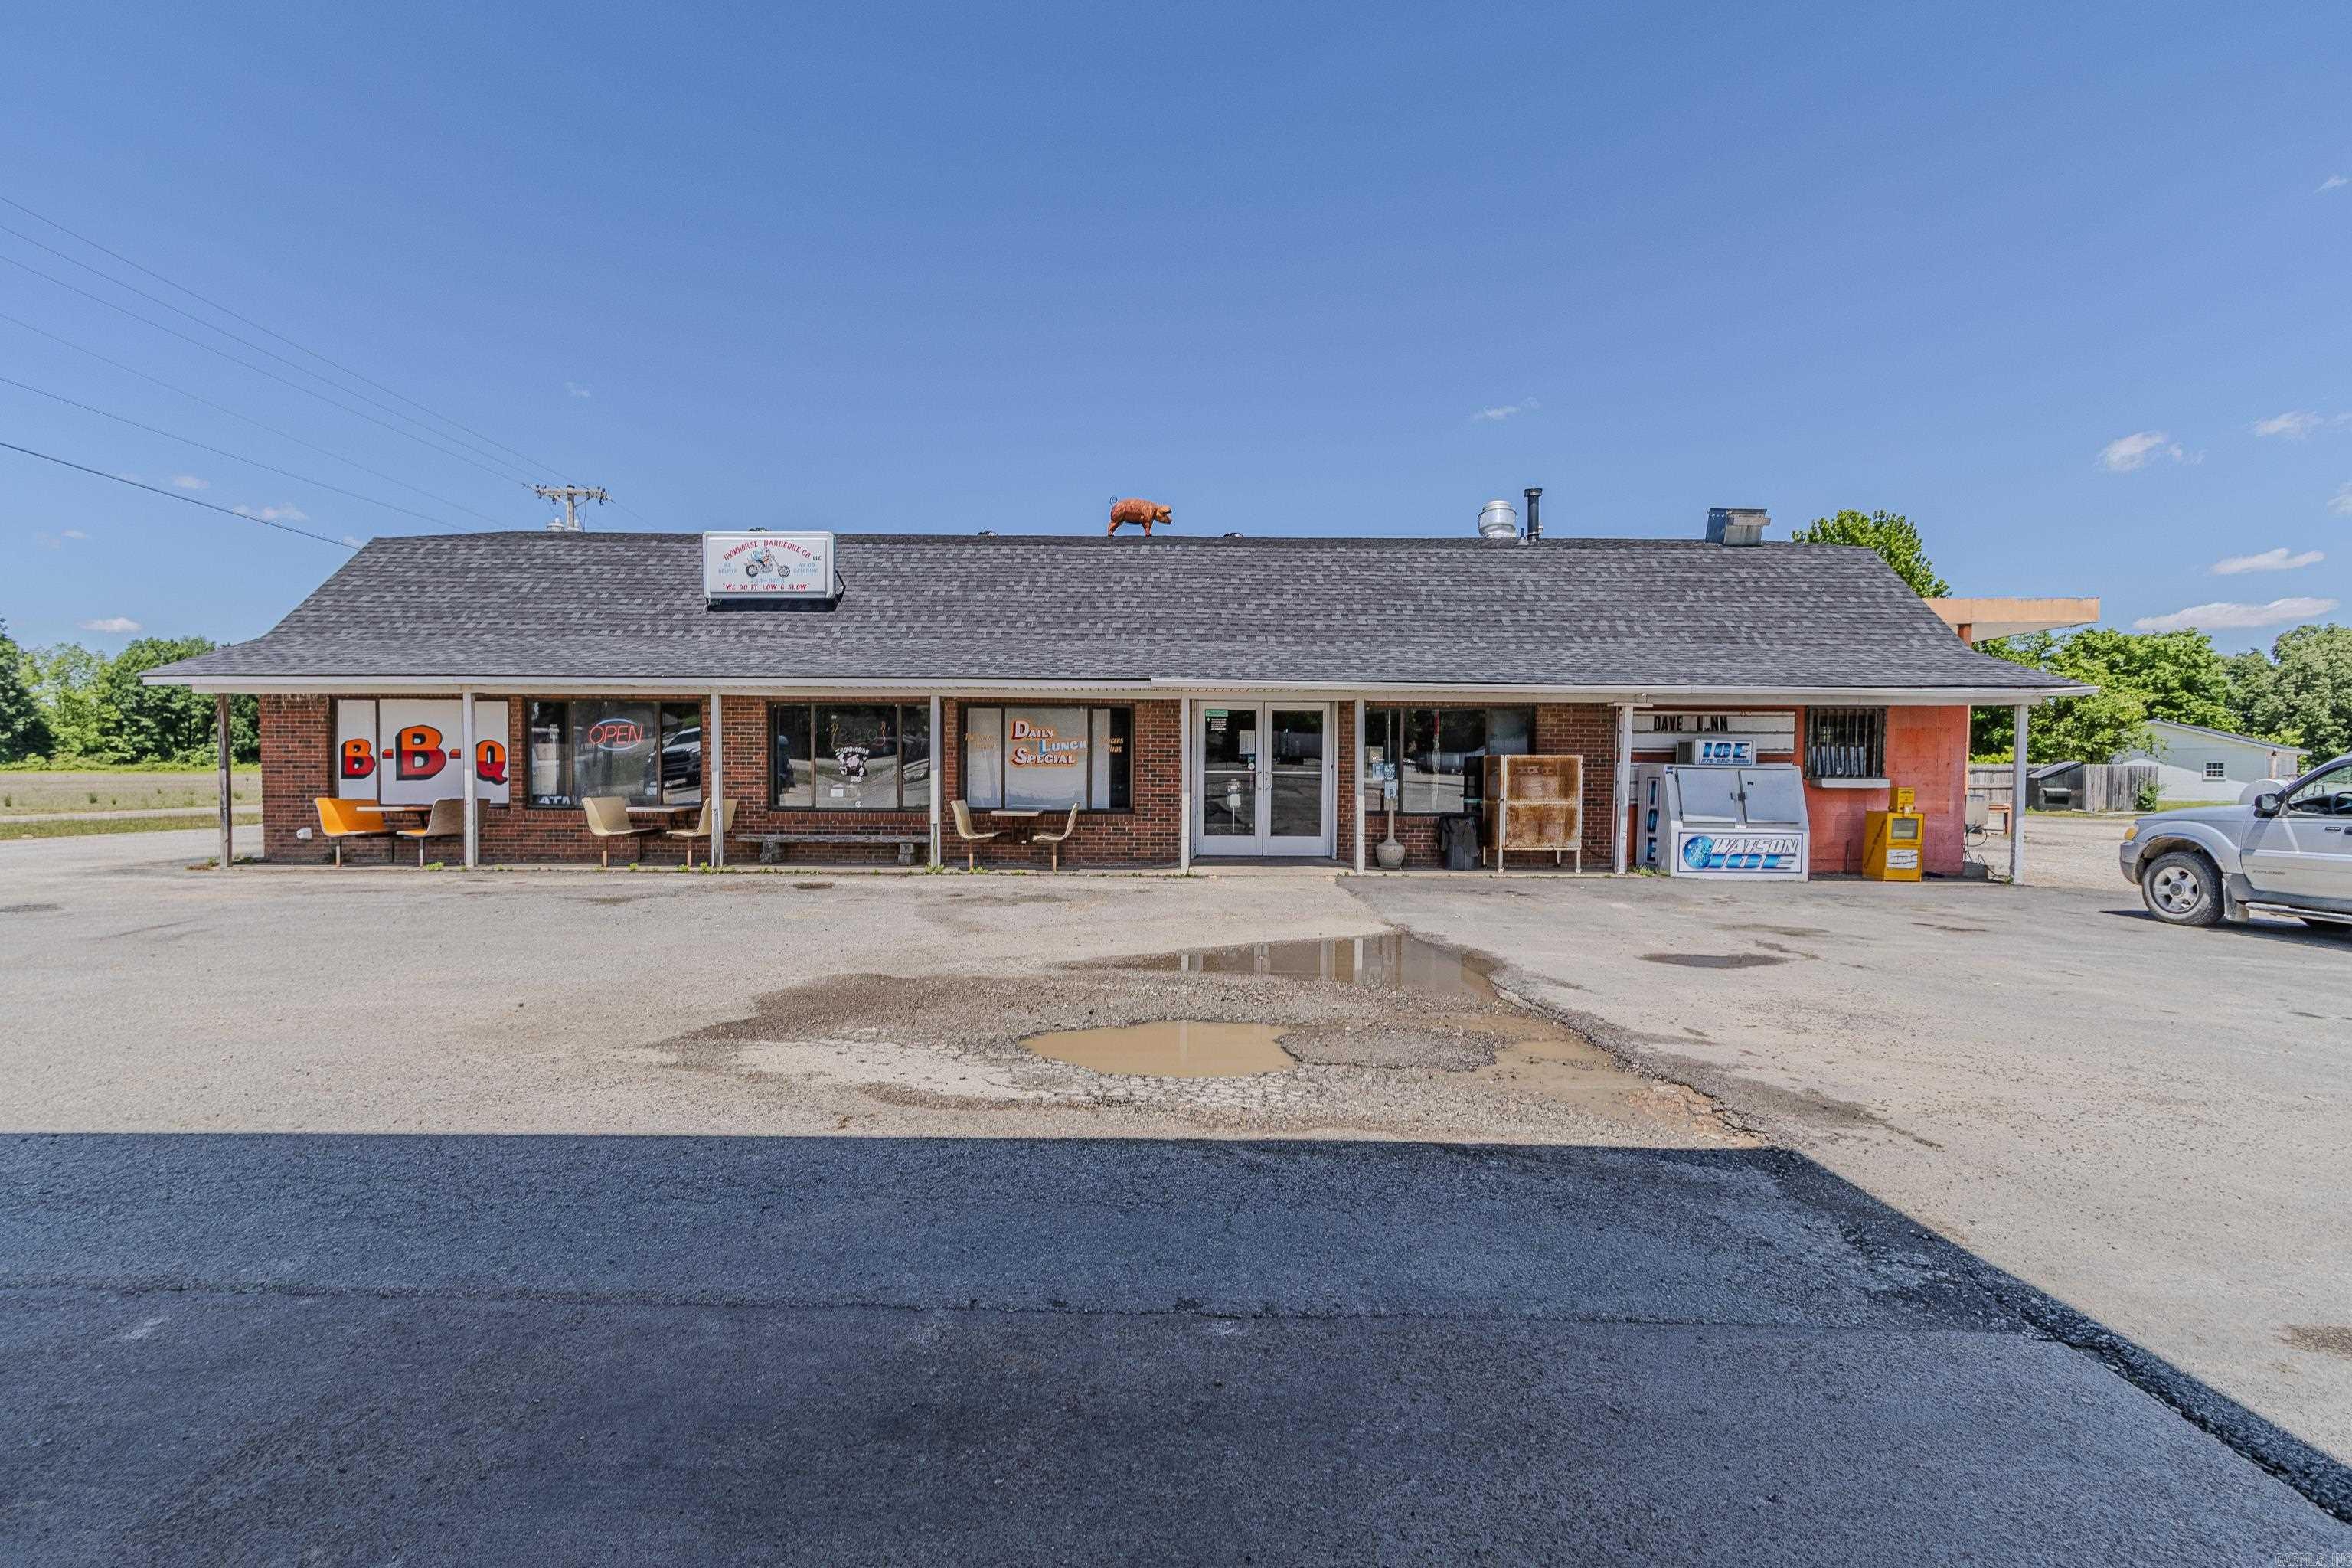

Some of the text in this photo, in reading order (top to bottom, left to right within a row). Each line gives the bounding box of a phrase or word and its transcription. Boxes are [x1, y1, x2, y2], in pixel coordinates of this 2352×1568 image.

[1654, 716, 1684, 731] DAVE
[589, 722, 643, 745] OPEN
[1703, 743, 1750, 758] ICE
[1647, 780, 1658, 861] ICE
[1713, 838, 1798, 854] WATSON
[1707, 854, 1796, 869] ICE
